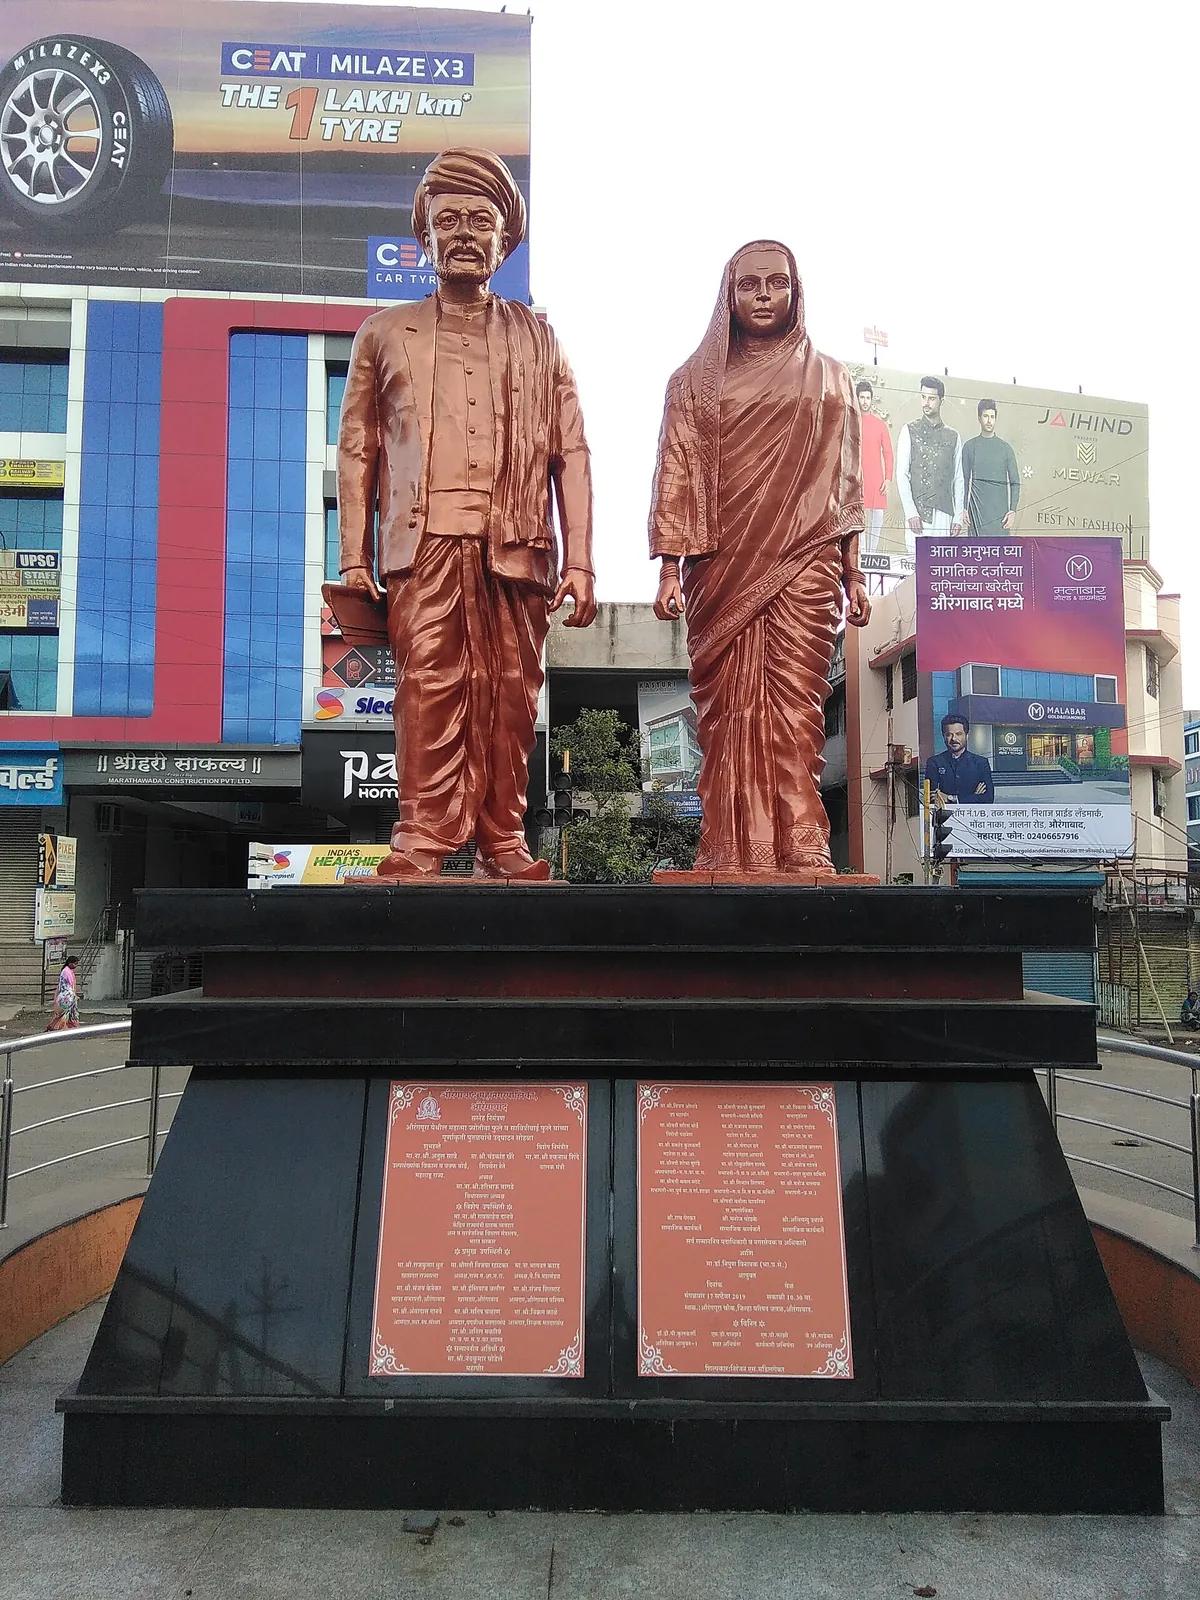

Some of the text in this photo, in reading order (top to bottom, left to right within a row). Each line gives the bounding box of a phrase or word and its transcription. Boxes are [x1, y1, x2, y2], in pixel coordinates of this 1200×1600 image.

[231, 49, 464, 78] CEAT MILAZE X3
[219, 83, 282, 109] THE
[285, 87, 319, 140] 1
[323, 88, 411, 115] LAKH
[320, 117, 402, 143] TYRE
[111, 111, 127, 169] CEAT
[376, 273, 403, 283] CAR
[1038, 409, 1133, 436] JAIHIND
[1052, 466, 1121, 486] MEWAR
[1037, 512, 1063, 525] FEST
[1083, 518, 1133, 534] FASHION
[20, 554, 56, 567] UPSC
[930, 545, 1023, 562] आता अनुभव घ्या
[930, 562, 1024, 577] जागतिक दर्जाच्या
[930, 579, 1024, 592] दागिन्यांच्या खरेदीचा
[1053, 586, 1106, 595] मलाबार
[930, 593, 994, 611] औरंगाबाद
[1047, 706, 1086, 716] MALABAR
[112, 752, 247, 773] श्रीहरी साफल्य
[1006, 810, 1030, 818] मजला,
[987, 821, 1006, 830] नाका,
[1008, 821, 1032, 829] जालना
[1033, 820, 1048, 830] रोड,
[1048, 820, 1086, 830] औरंगाबाद,
[1006, 832, 1025, 840] फोन:
[1026, 832, 1080, 840] 02406657916
[58, 843, 75, 855] PIXEL
[328, 849, 361, 857] INDIA'S
